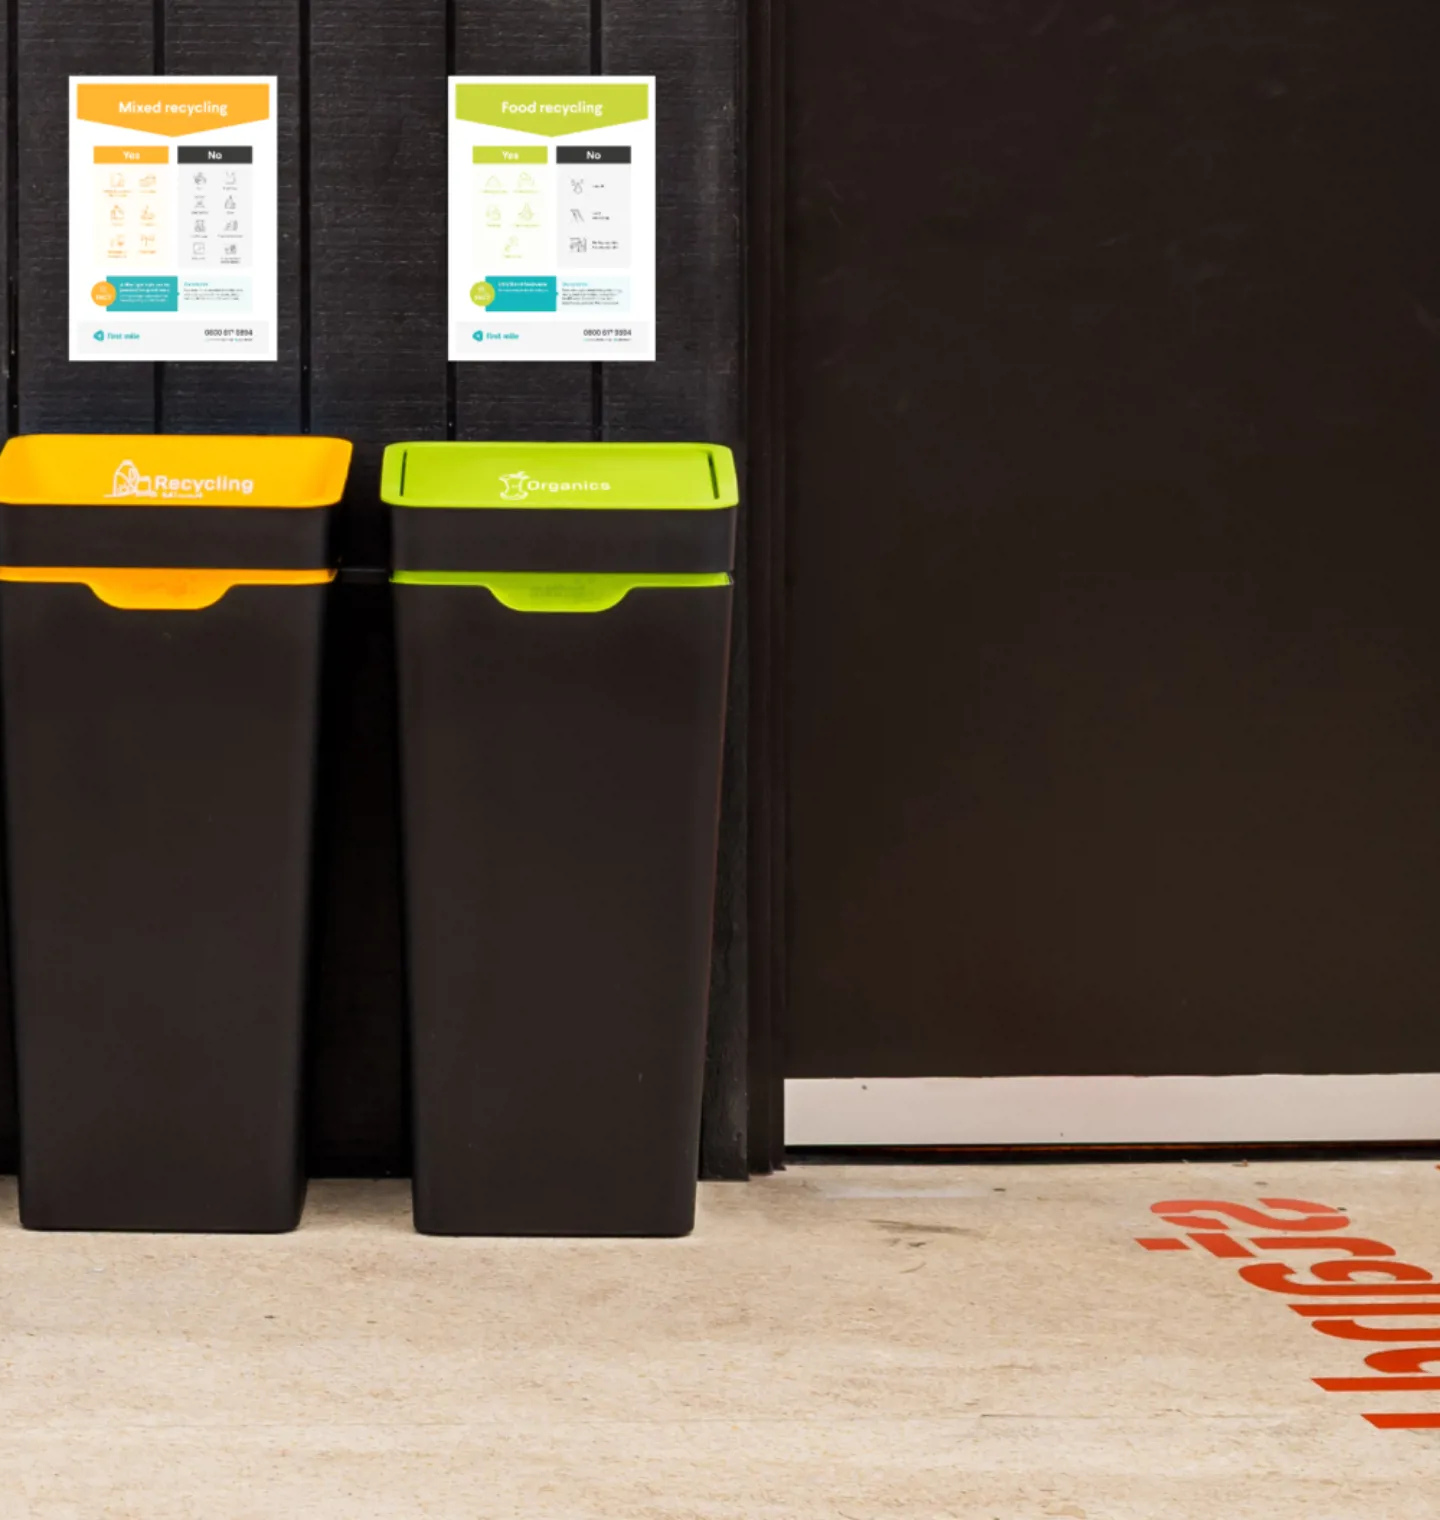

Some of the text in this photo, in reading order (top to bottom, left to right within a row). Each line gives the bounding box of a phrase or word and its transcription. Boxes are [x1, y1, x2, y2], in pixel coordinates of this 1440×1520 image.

[118, 101, 228, 117] Mixed recycling
[501, 101, 603, 117] Food recycling
[122, 150, 141, 160] Yes
[207, 150, 223, 160] No
[501, 150, 520, 160] Yes
[586, 150, 602, 160] No
[154, 475, 254, 495] Recycling
[527, 480, 611, 493] Organics
